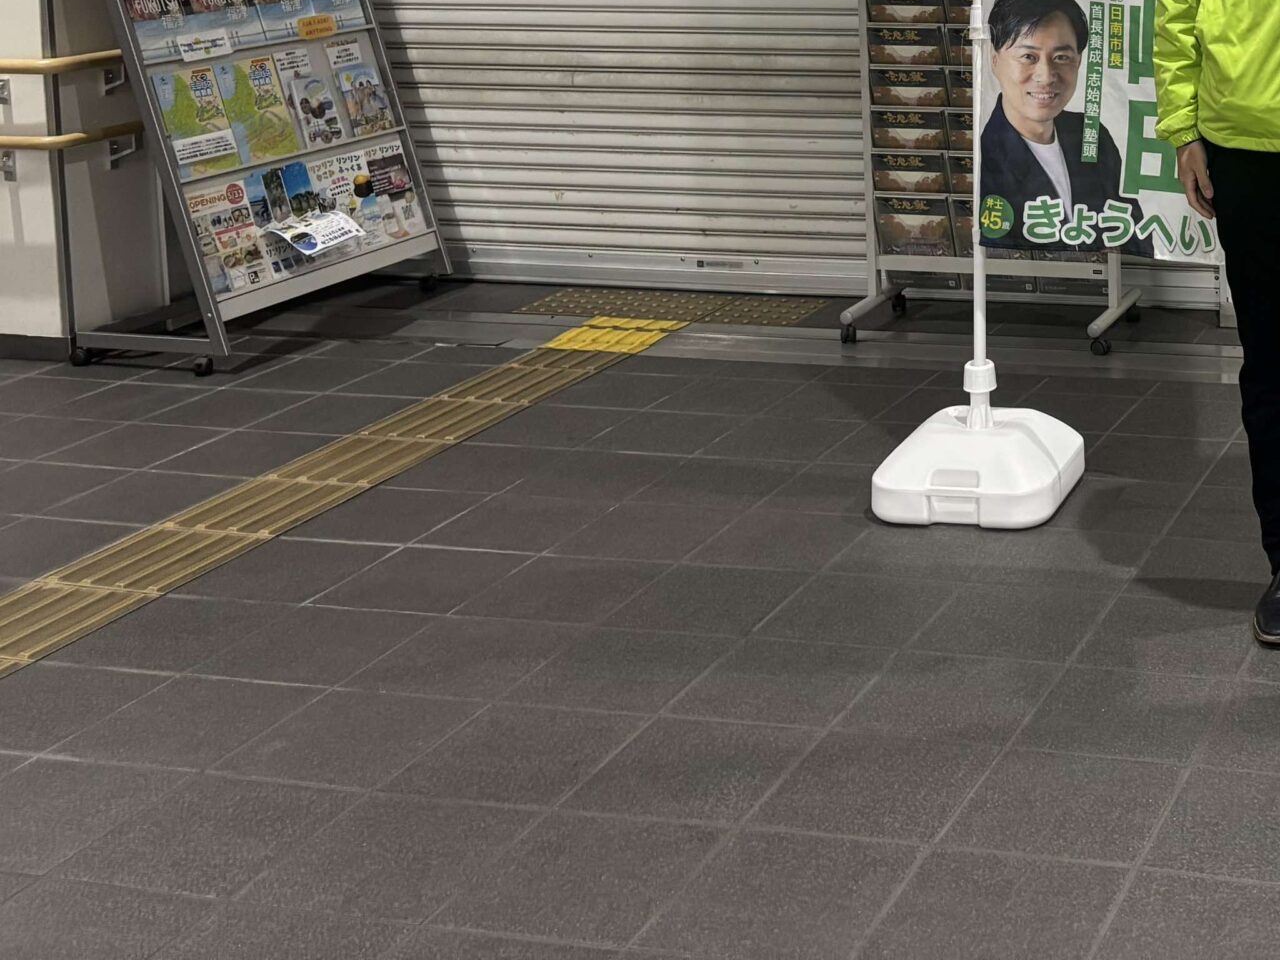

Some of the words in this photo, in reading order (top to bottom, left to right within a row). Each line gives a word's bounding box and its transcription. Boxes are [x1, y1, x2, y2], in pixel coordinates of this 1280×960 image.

[189, 193, 227, 210] OPENING
[1023, 196, 1214, 254] きょうへい
